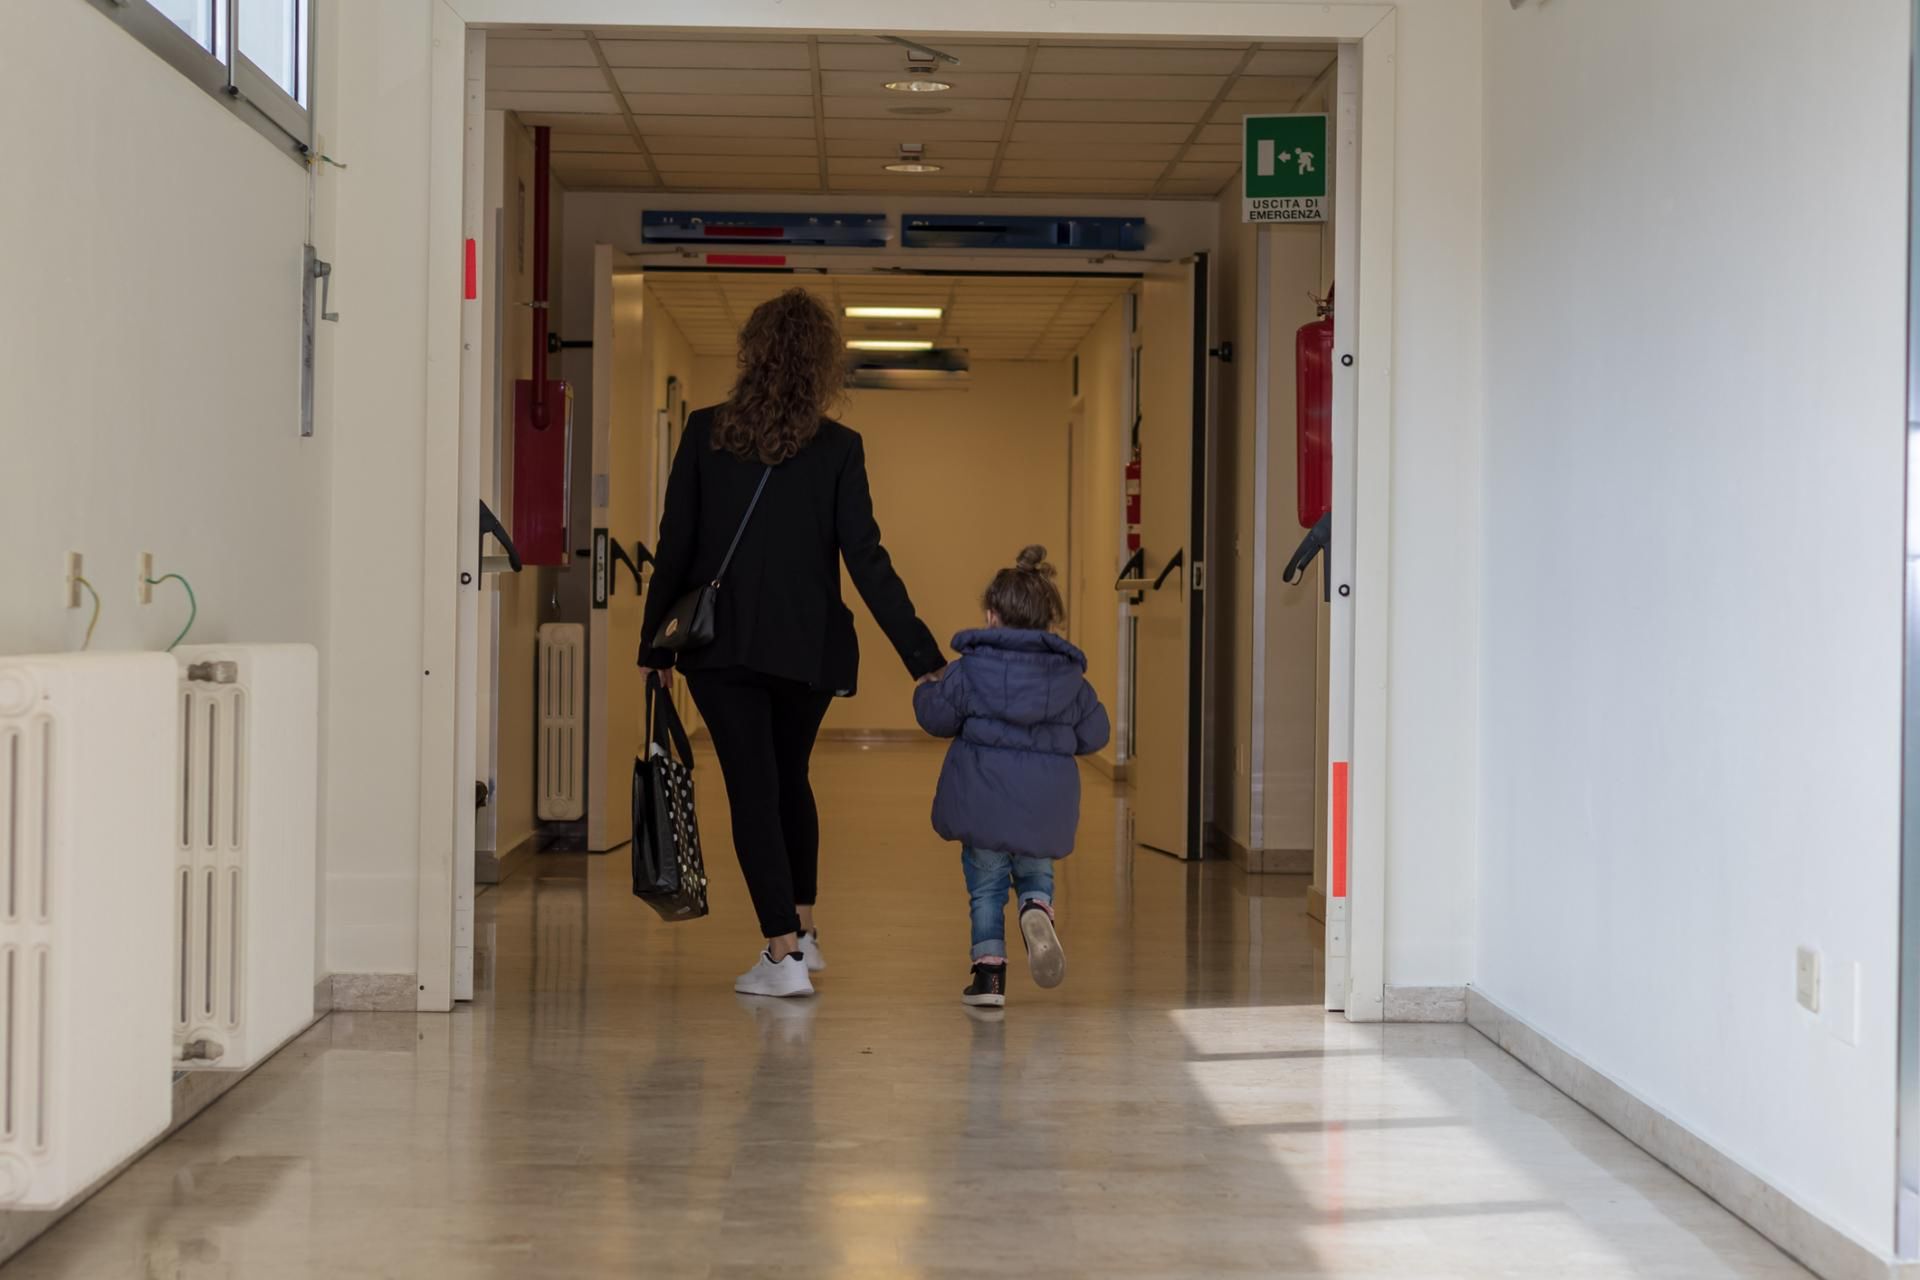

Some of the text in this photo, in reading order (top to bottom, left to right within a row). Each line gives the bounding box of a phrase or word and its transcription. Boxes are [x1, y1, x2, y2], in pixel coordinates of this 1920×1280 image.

[1253, 199, 1318, 209] USCITA DI
[1249, 209, 1321, 220] EMERGENZA
